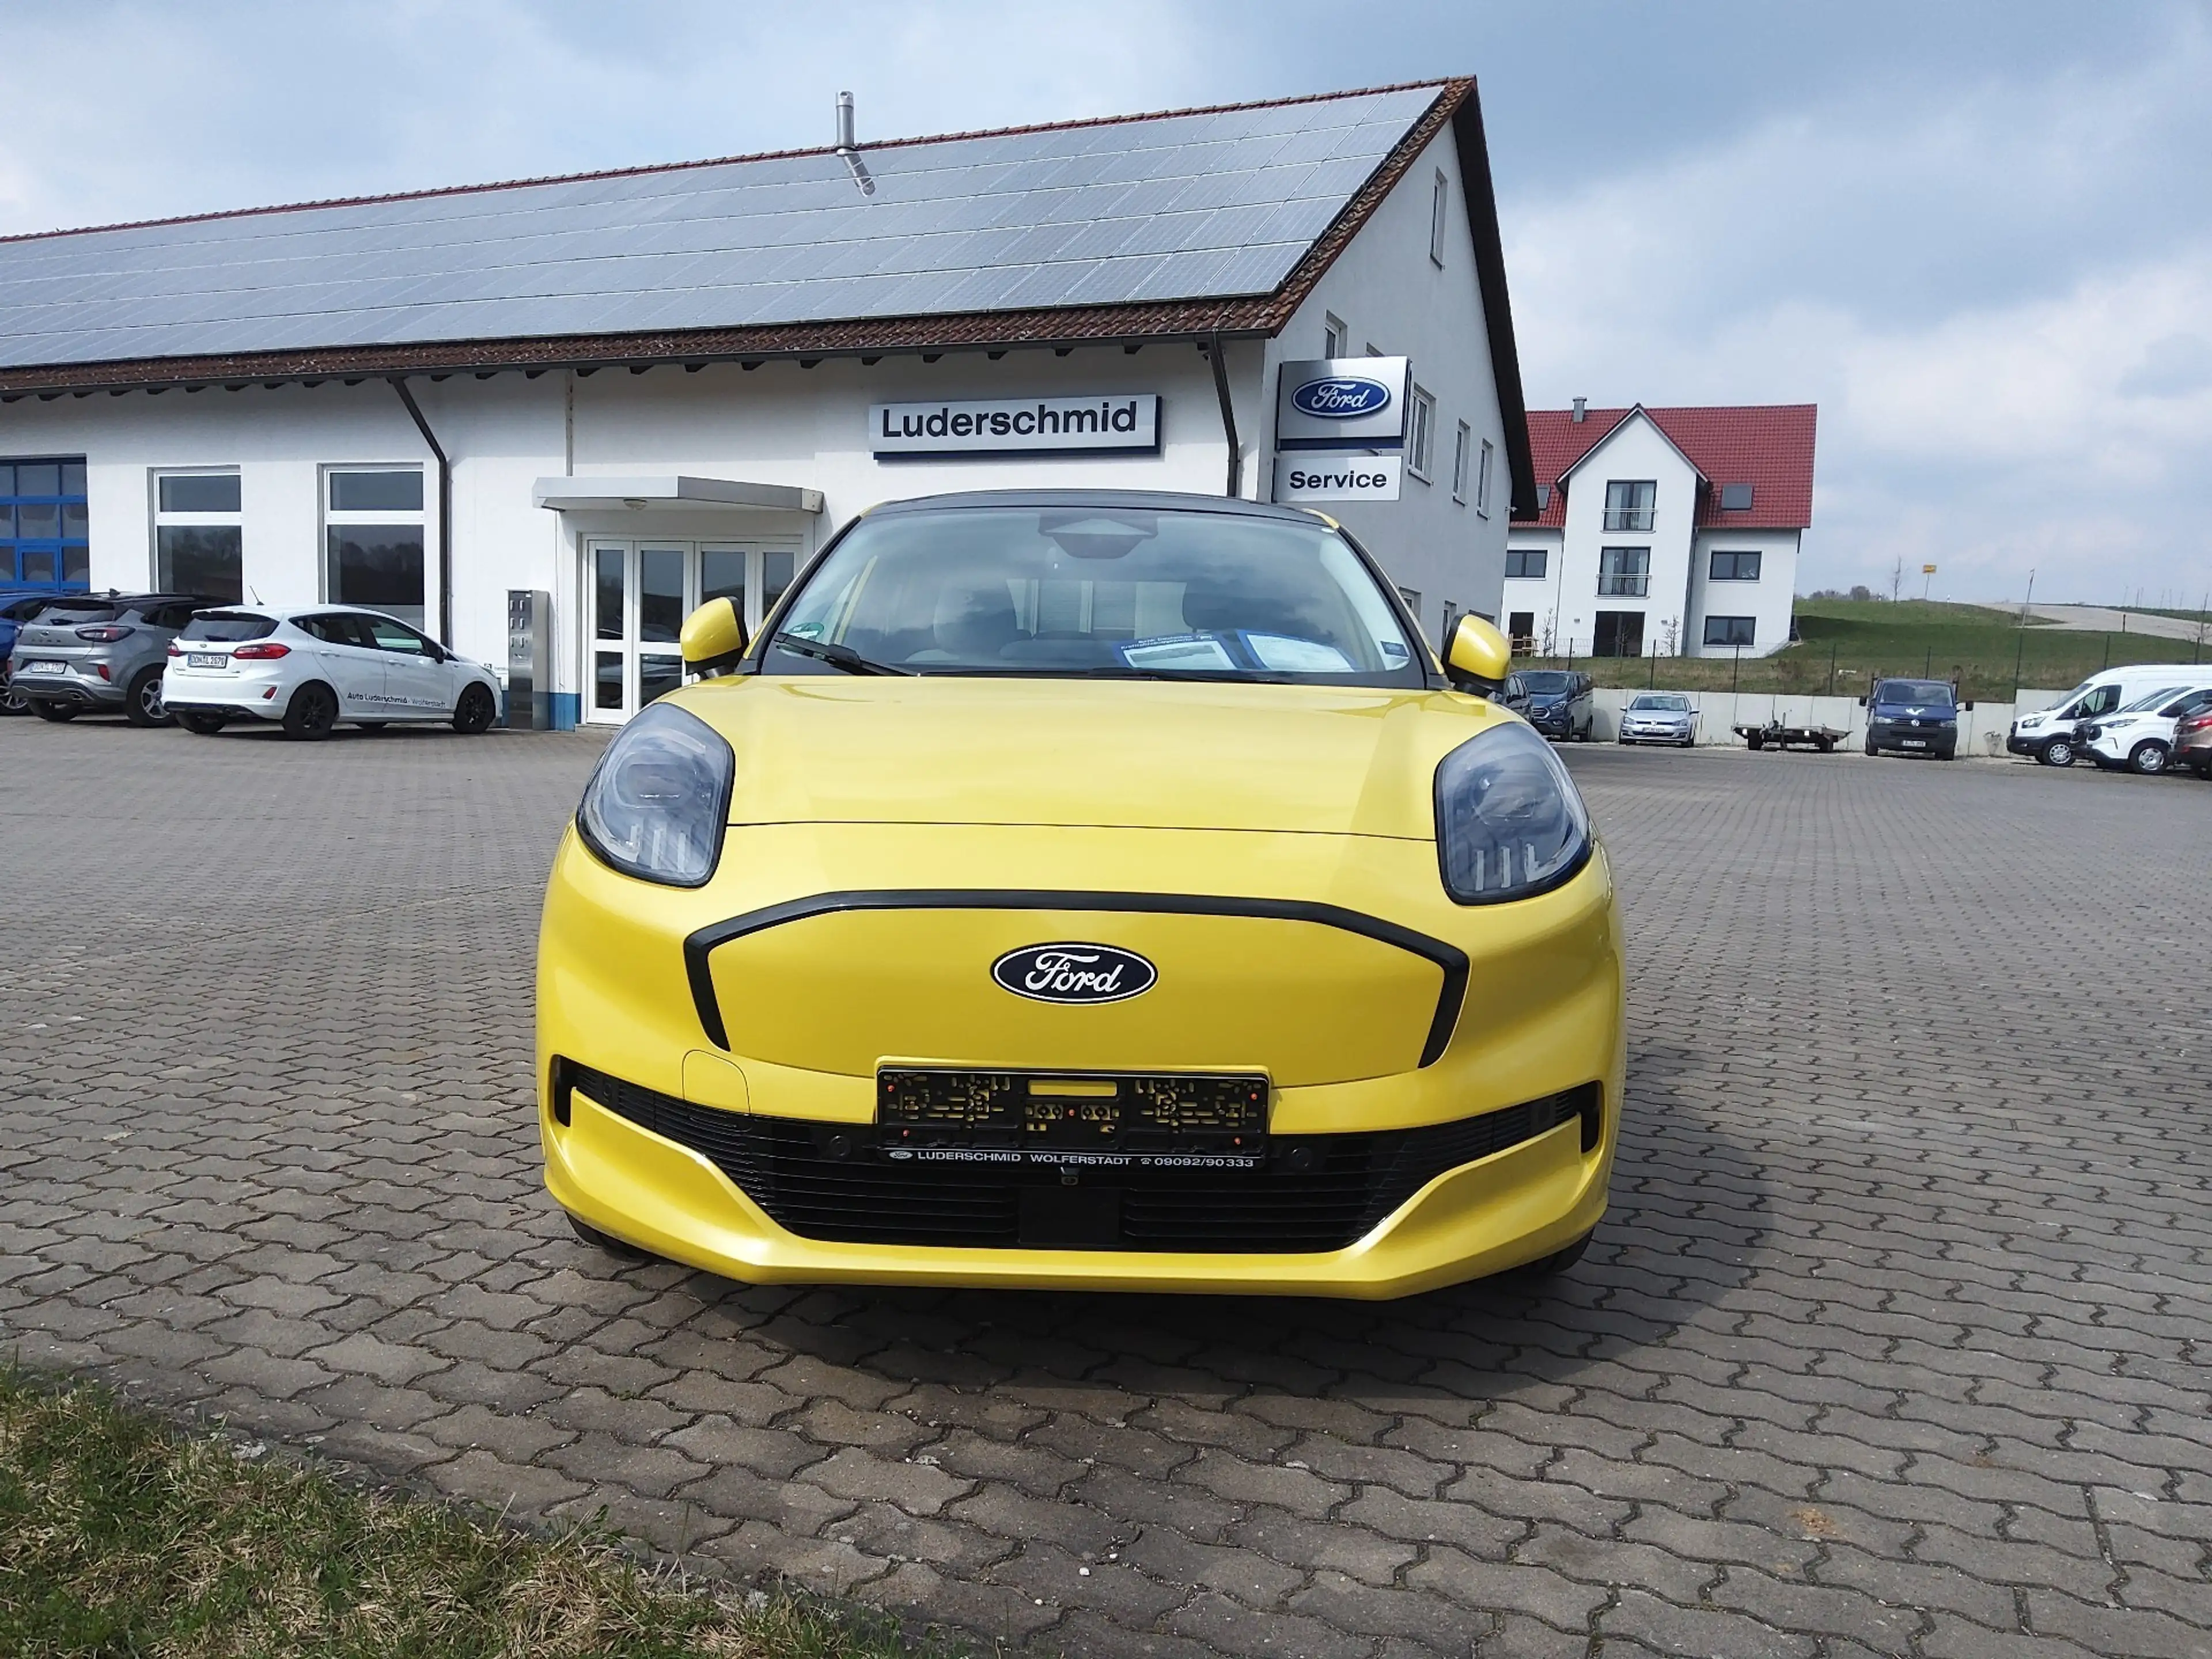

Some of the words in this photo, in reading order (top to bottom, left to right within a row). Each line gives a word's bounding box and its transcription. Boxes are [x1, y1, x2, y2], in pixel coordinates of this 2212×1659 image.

[1311, 384, 1371, 409] Ford
[882, 401, 1137, 438] Luderschmid
[1289, 470, 1387, 490] Service
[347, 692, 363, 700] Auto
[365, 693, 408, 704] Luderschmid
[1025, 952, 1124, 992] Ford
[918, 1152, 1021, 1162] LUDERSCHMID
[1030, 1154, 1132, 1165] WOLFERSTADT
